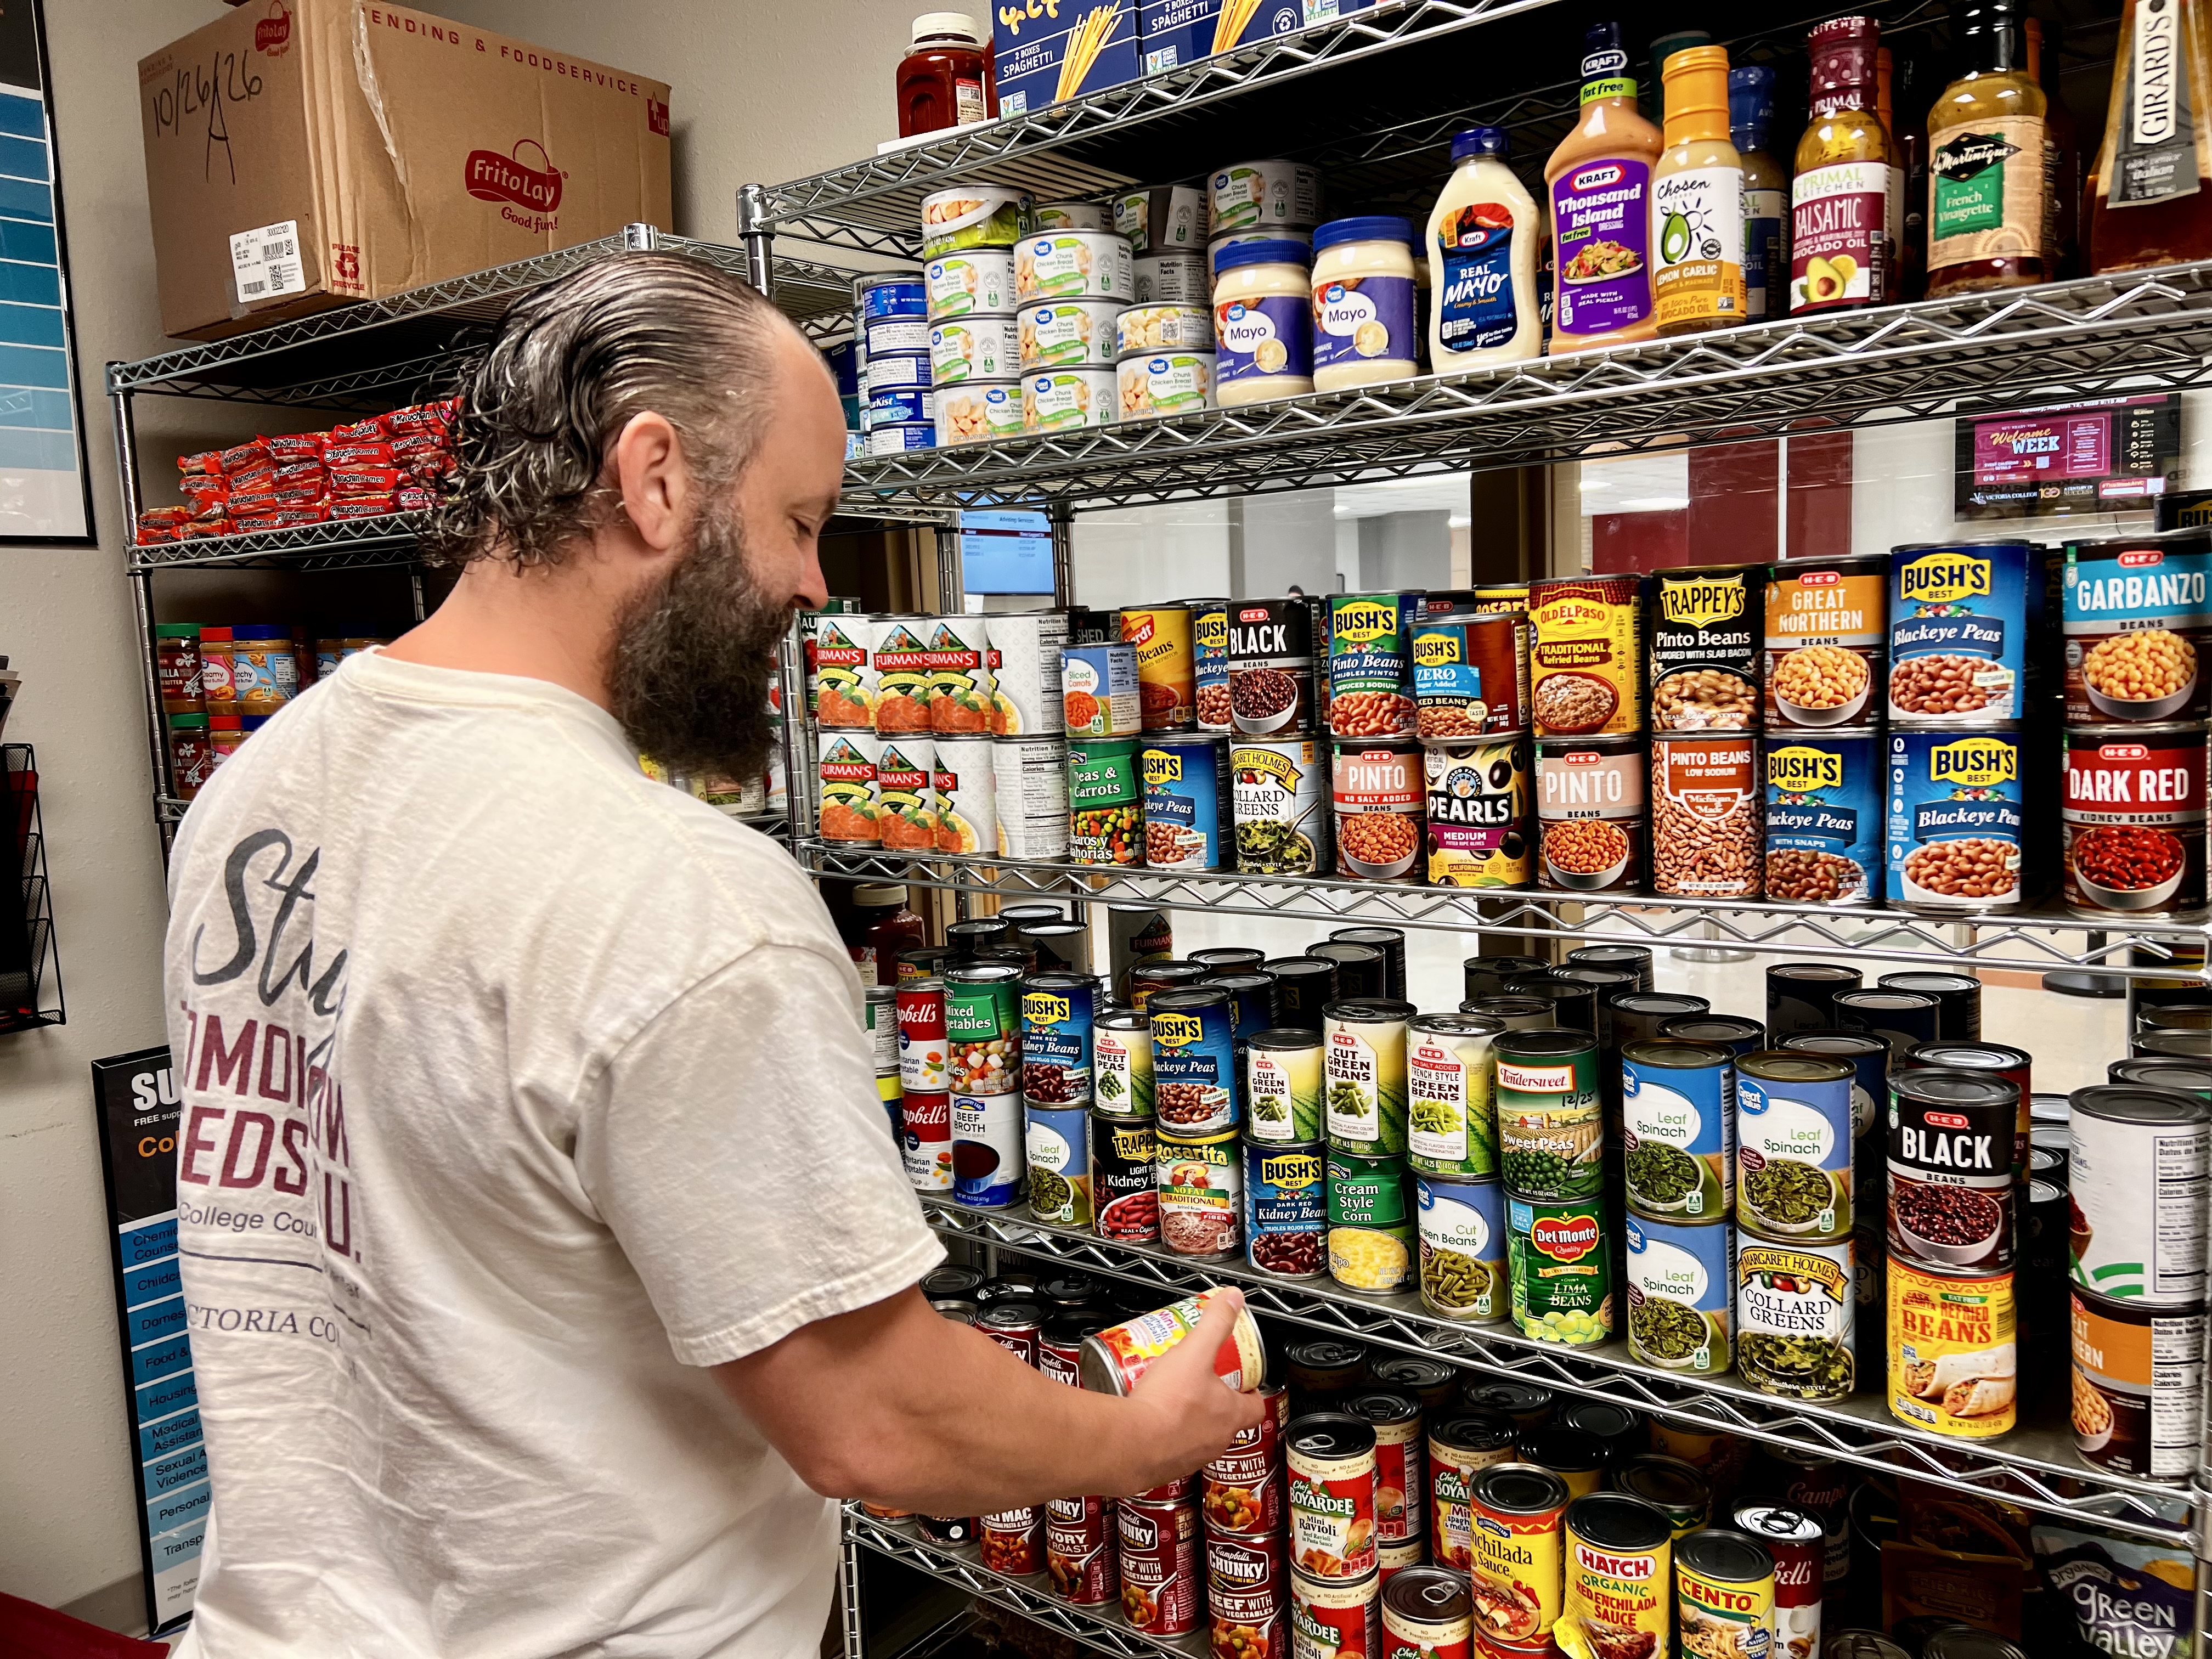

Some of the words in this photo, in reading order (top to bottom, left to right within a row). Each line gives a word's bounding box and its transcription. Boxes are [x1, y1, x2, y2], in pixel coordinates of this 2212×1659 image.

[1152, 0, 1207, 31] SPAGHETTI
[1015, 52, 1019, 60] 2
[1020, 45, 1040, 57] BOXES
[501, 46, 638, 95] FOODSERVICE
[1003, 50, 1053, 77] SPAGHETTI
[2140, 18, 2171, 137] GIRARD'S
[1583, 86, 1596, 101] fat
[1599, 82, 1623, 93] free
[475, 160, 554, 206] FritoLay
[1578, 170, 1616, 185] KRAFT
[1803, 168, 1863, 191] PRIMAL
[1658, 180, 1709, 200] Chosen
[1803, 180, 1864, 199] KITCHEN
[1558, 184, 1641, 215] Thousand
[1946, 191, 1982, 208] French
[501, 207, 532, 229] Good
[534, 218, 557, 233] fun!
[1572, 204, 1623, 229] Island
[1796, 198, 1862, 241] BALSAMIC
[1465, 234, 1481, 243] Kraft
[1847, 239, 1866, 249] OIL
[332, 244, 360, 253] PLEASE
[1460, 264, 1491, 279] REAL
[1657, 269, 1679, 286] LEMON
[1683, 264, 1718, 278] GARLIC
[334, 280, 364, 290] RECYCLE
[1444, 273, 1508, 306] MAYO
[1596, 296, 1623, 304] PICKLES
[1328, 307, 1367, 324] Mayo
[1661, 306, 1695, 320] AVOCADO
[1230, 325, 1267, 341] Mayo
[396, 409, 430, 425] Maruchan
[1990, 427, 2051, 446] Welcome
[2012, 436, 2059, 454] WEEK
[361, 475, 385, 484] Ramen
[1791, 588, 1846, 611] GREAT
[2077, 572, 2206, 611] GARBANZO
[1662, 586, 1745, 619] TRAPPEY'S
[1779, 610, 1863, 633] NORTHERN
[1230, 624, 1286, 655] BLACK
[1656, 631, 1694, 647] Pinto
[1698, 631, 1751, 646] Beans
[1894, 624, 1958, 647] Blackeye
[1961, 624, 2001, 643] Peas
[876, 654, 930, 667] FURMAN'S
[1544, 656, 1572, 665] Refried
[203, 670, 224, 679] Creamy
[1068, 679, 1091, 687] Carrots
[1069, 670, 1091, 680] Sliced
[1335, 670, 1365, 679] FRIJOLES
[1336, 682, 1365, 692] REDUCED
[1685, 768, 1702, 777] LOW
[1704, 768, 1736, 776] SODIUM
[1074, 782, 1120, 797] Carrots
[1545, 770, 1622, 804] PINTO
[2069, 770, 2131, 802] DARK
[2140, 768, 2189, 802] RED
[1430, 797, 1509, 824] PEARLS
[1918, 808, 1995, 828] Blackeye
[2080, 814, 2122, 822] KIDNEY
[2129, 812, 2173, 822] BEANS
[1443, 832, 1486, 840] MEDIUM
[1794, 839, 1825, 848] SNAPS
[1023, 998, 1068, 1018] BUSH'S
[1047, 1041, 1079, 1055] Beans
[1333, 1048, 1358, 1060] CUT
[1097, 1052, 1126, 1063] SWEET
[1328, 1057, 1370, 1070] GREEN
[1098, 1062, 1125, 1071] PEAS
[1190, 1059, 1215, 1074] Peas
[1412, 1066, 1432, 1080] FRENCH
[1435, 1071, 1459, 1081] STYLE
[1412, 1077, 1459, 1092] GREEN
[1500, 1066, 1566, 1088] Tendersweet
[1562, 1090, 1595, 1109] 12/25
[1737, 1085, 1762, 1103] Great
[134, 1113, 160, 1126] FREE
[957, 1111, 980, 1122] BEEF
[954, 1121, 985, 1133] BROTH
[1637, 1121, 1686, 1138] Spinach
[1502, 1128, 1539, 1151] Sweet
[1902, 1127, 1993, 1169] BLACK
[1040, 1143, 1059, 1154] Leaf
[1157, 1143, 1228, 1166] Rosarita
[1130, 1166, 1147, 1175] LIGHT
[1187, 1186, 1206, 1195] FAT
[1335, 1182, 1379, 1195] Cream
[1166, 1193, 1216, 1205] TRADITIONAL
[1339, 1196, 1374, 1208] Style
[178, 1201, 264, 1232] College
[1258, 1207, 1297, 1221] Kidney
[1342, 1210, 1372, 1221] Corn
[1455, 1224, 1476, 1235] Cut
[1537, 1227, 1557, 1243] Del
[1559, 1226, 1596, 1242] Monte
[1555, 1244, 1581, 1255] Quality
[1743, 1252, 1791, 1267] MARGARET
[1794, 1255, 1838, 1278] HOLMES
[1554, 1283, 1588, 1295] LIMA
[1746, 1289, 1832, 1315] COLLARD
[1750, 1306, 1825, 1330] GREENS
[1939, 1301, 1989, 1322] REFRIED
[1901, 1308, 1992, 1344] BEANS
[145, 1353, 176, 1369] Food
[180, 1347, 188, 1357] &
[149, 1384, 197, 1407] Housing
[152, 1413, 198, 1439] Medical
[155, 1456, 196, 1476] Sexual
[1217, 1468, 1267, 1481] VEGETABLES
[157, 1463, 207, 1489] Violence
[1293, 1480, 1308, 1492] Chef
[159, 1491, 210, 1519] Personal
[1290, 1486, 1355, 1515] BOYARDEE
[1006, 1506, 1032, 1522] MAC
[1307, 1515, 1325, 1526] Mini
[1299, 1518, 1337, 1536] Ravioli
[1052, 1543, 1088, 1554] ROAST
[1216, 1545, 1251, 1562] Campbell's
[1138, 1561, 1162, 1575] WITH
[1209, 1555, 1263, 1578] CHUNKY
[1478, 1551, 1510, 1577] Sauce
[1582, 1548, 1648, 1577] HATCH
[1582, 1574, 1649, 1597] ORGANIC
[1681, 1577, 1752, 1611] CENTO
[1209, 1598, 1246, 1612] BEEF
[1249, 1594, 1273, 1611] WITH
[1576, 1580, 1593, 1600] RED
[1595, 1594, 1657, 1612] ENCHILADA
[1595, 1606, 1636, 1626] SAUCE
